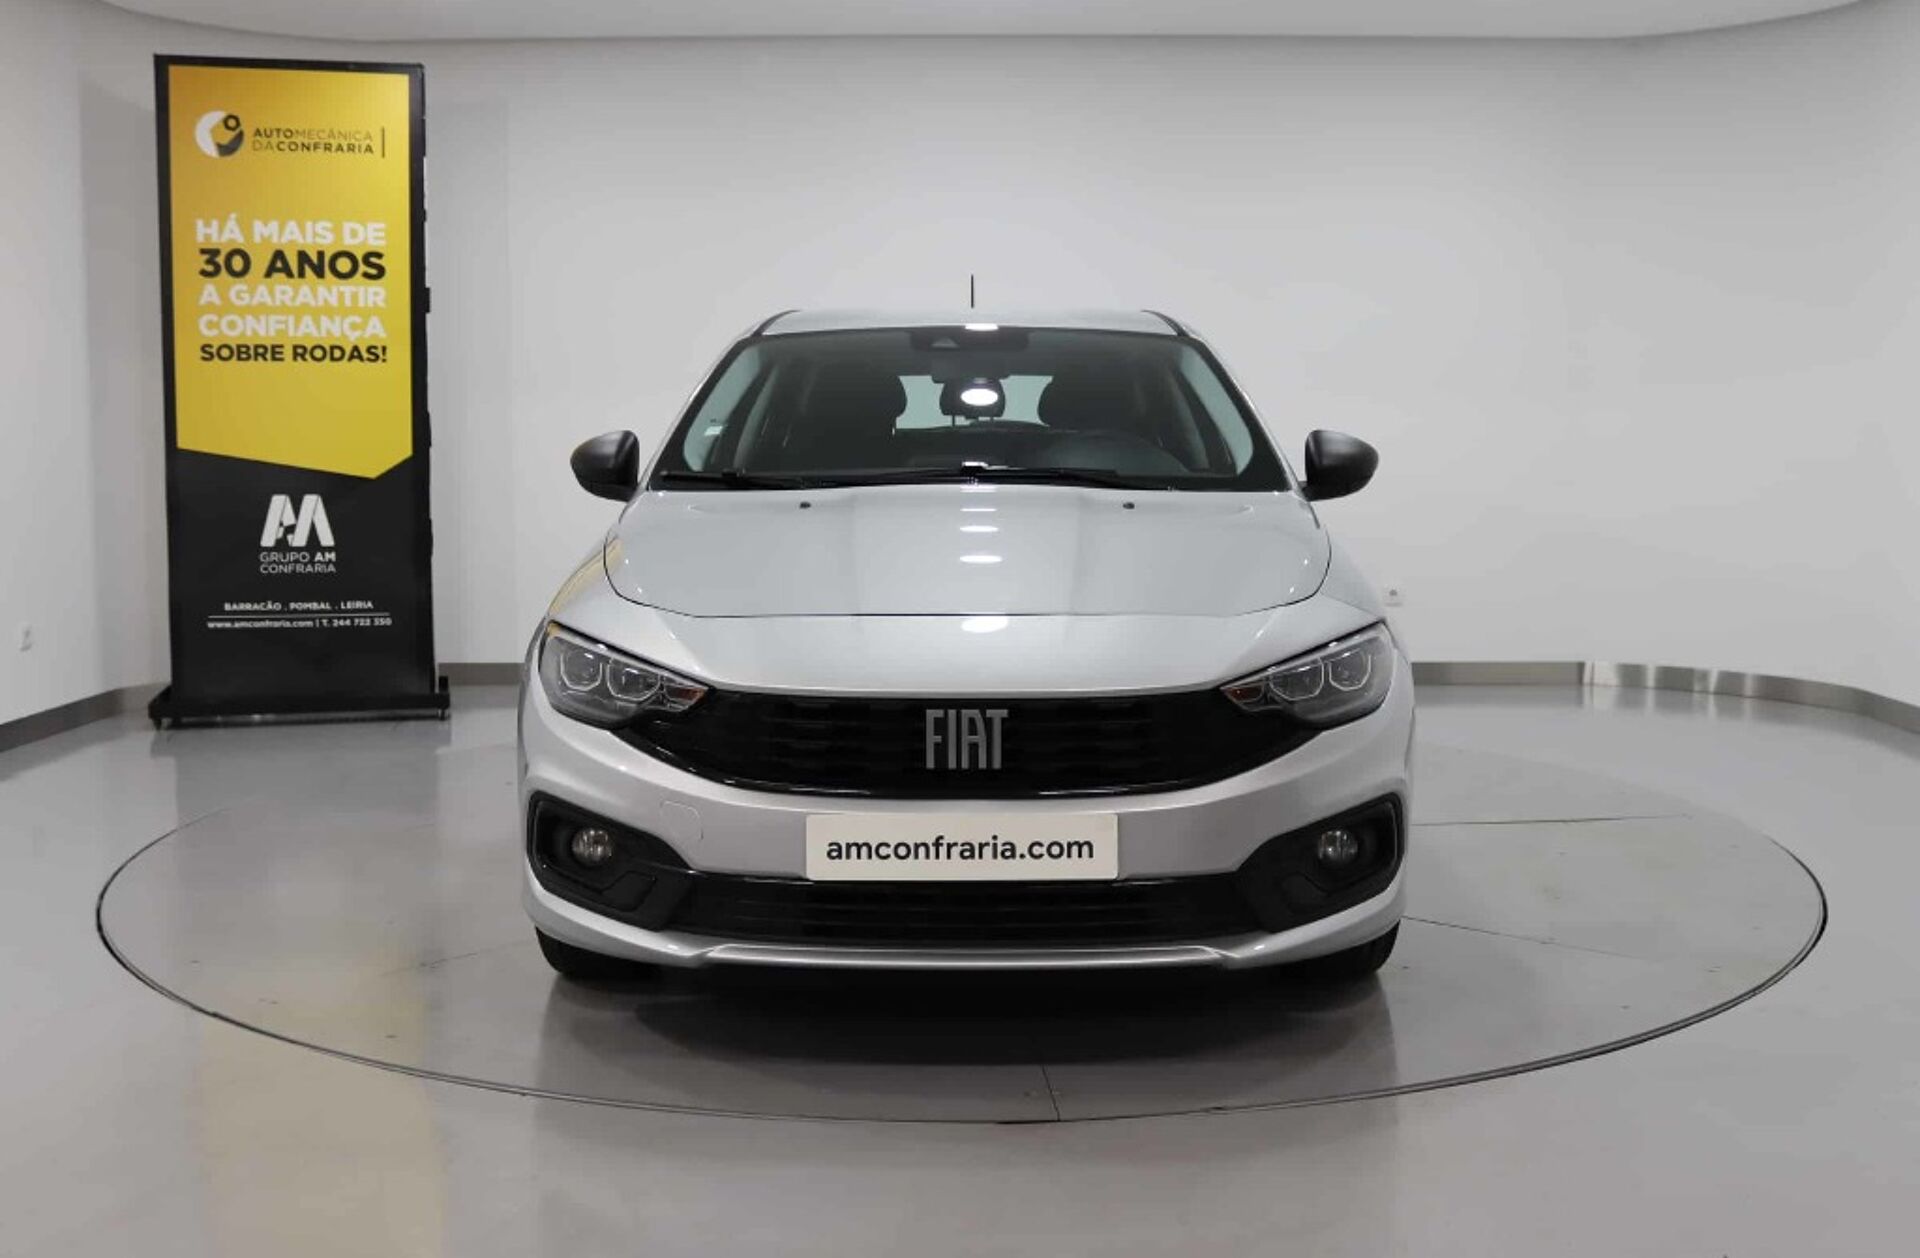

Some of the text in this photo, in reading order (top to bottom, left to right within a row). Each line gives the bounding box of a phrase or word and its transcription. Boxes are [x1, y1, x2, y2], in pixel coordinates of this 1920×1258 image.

[253, 127, 373, 142] AUTOMECÂNICA
[252, 141, 374, 154] DACONFRARIA
[196, 213, 386, 246] HÁ MAIS DE
[199, 248, 386, 280] 30 ANOS
[198, 285, 386, 308] A GARANTIR
[198, 314, 387, 341] CONFIANÇA
[200, 344, 387, 363] SOBRE RODAS!
[260, 551, 337, 563] GRUPO AM
[260, 563, 337, 574] CONFRARIA
[224, 600, 374, 611] BARRACÃO POMBAL LEIRIA
[925, 708, 1009, 769] FIAT
[826, 835, 1095, 861] amconfraria.com
